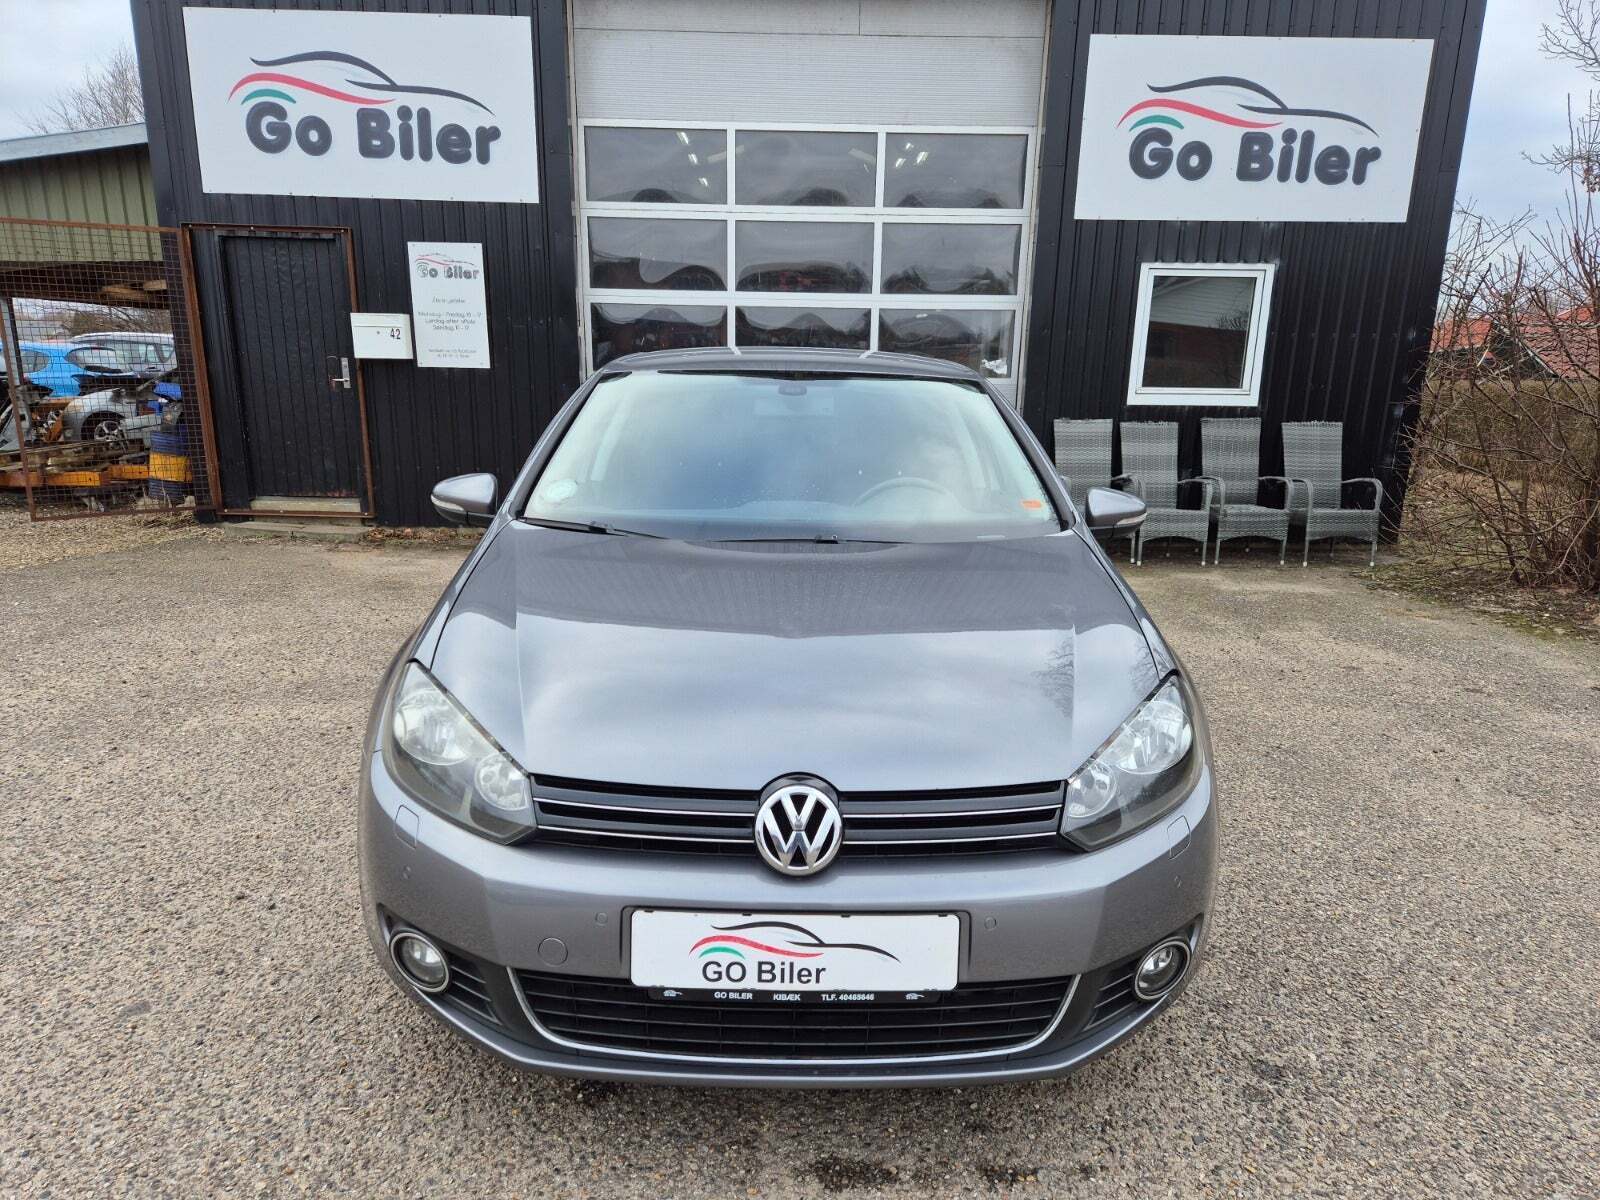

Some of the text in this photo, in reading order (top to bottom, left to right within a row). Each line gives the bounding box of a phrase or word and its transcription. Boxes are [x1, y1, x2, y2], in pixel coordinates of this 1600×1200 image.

[245, 101, 502, 165] Go Biler
[1128, 127, 1382, 186] Go Biler
[443, 265, 480, 280] Biler
[390, 328, 401, 340] 42
[702, 960, 826, 985] GO Biler
[714, 991, 728, 999] GO
[728, 992, 753, 1000] BILER
[773, 993, 801, 1001] KIBÆK
[821, 993, 838, 1001] TLF.
